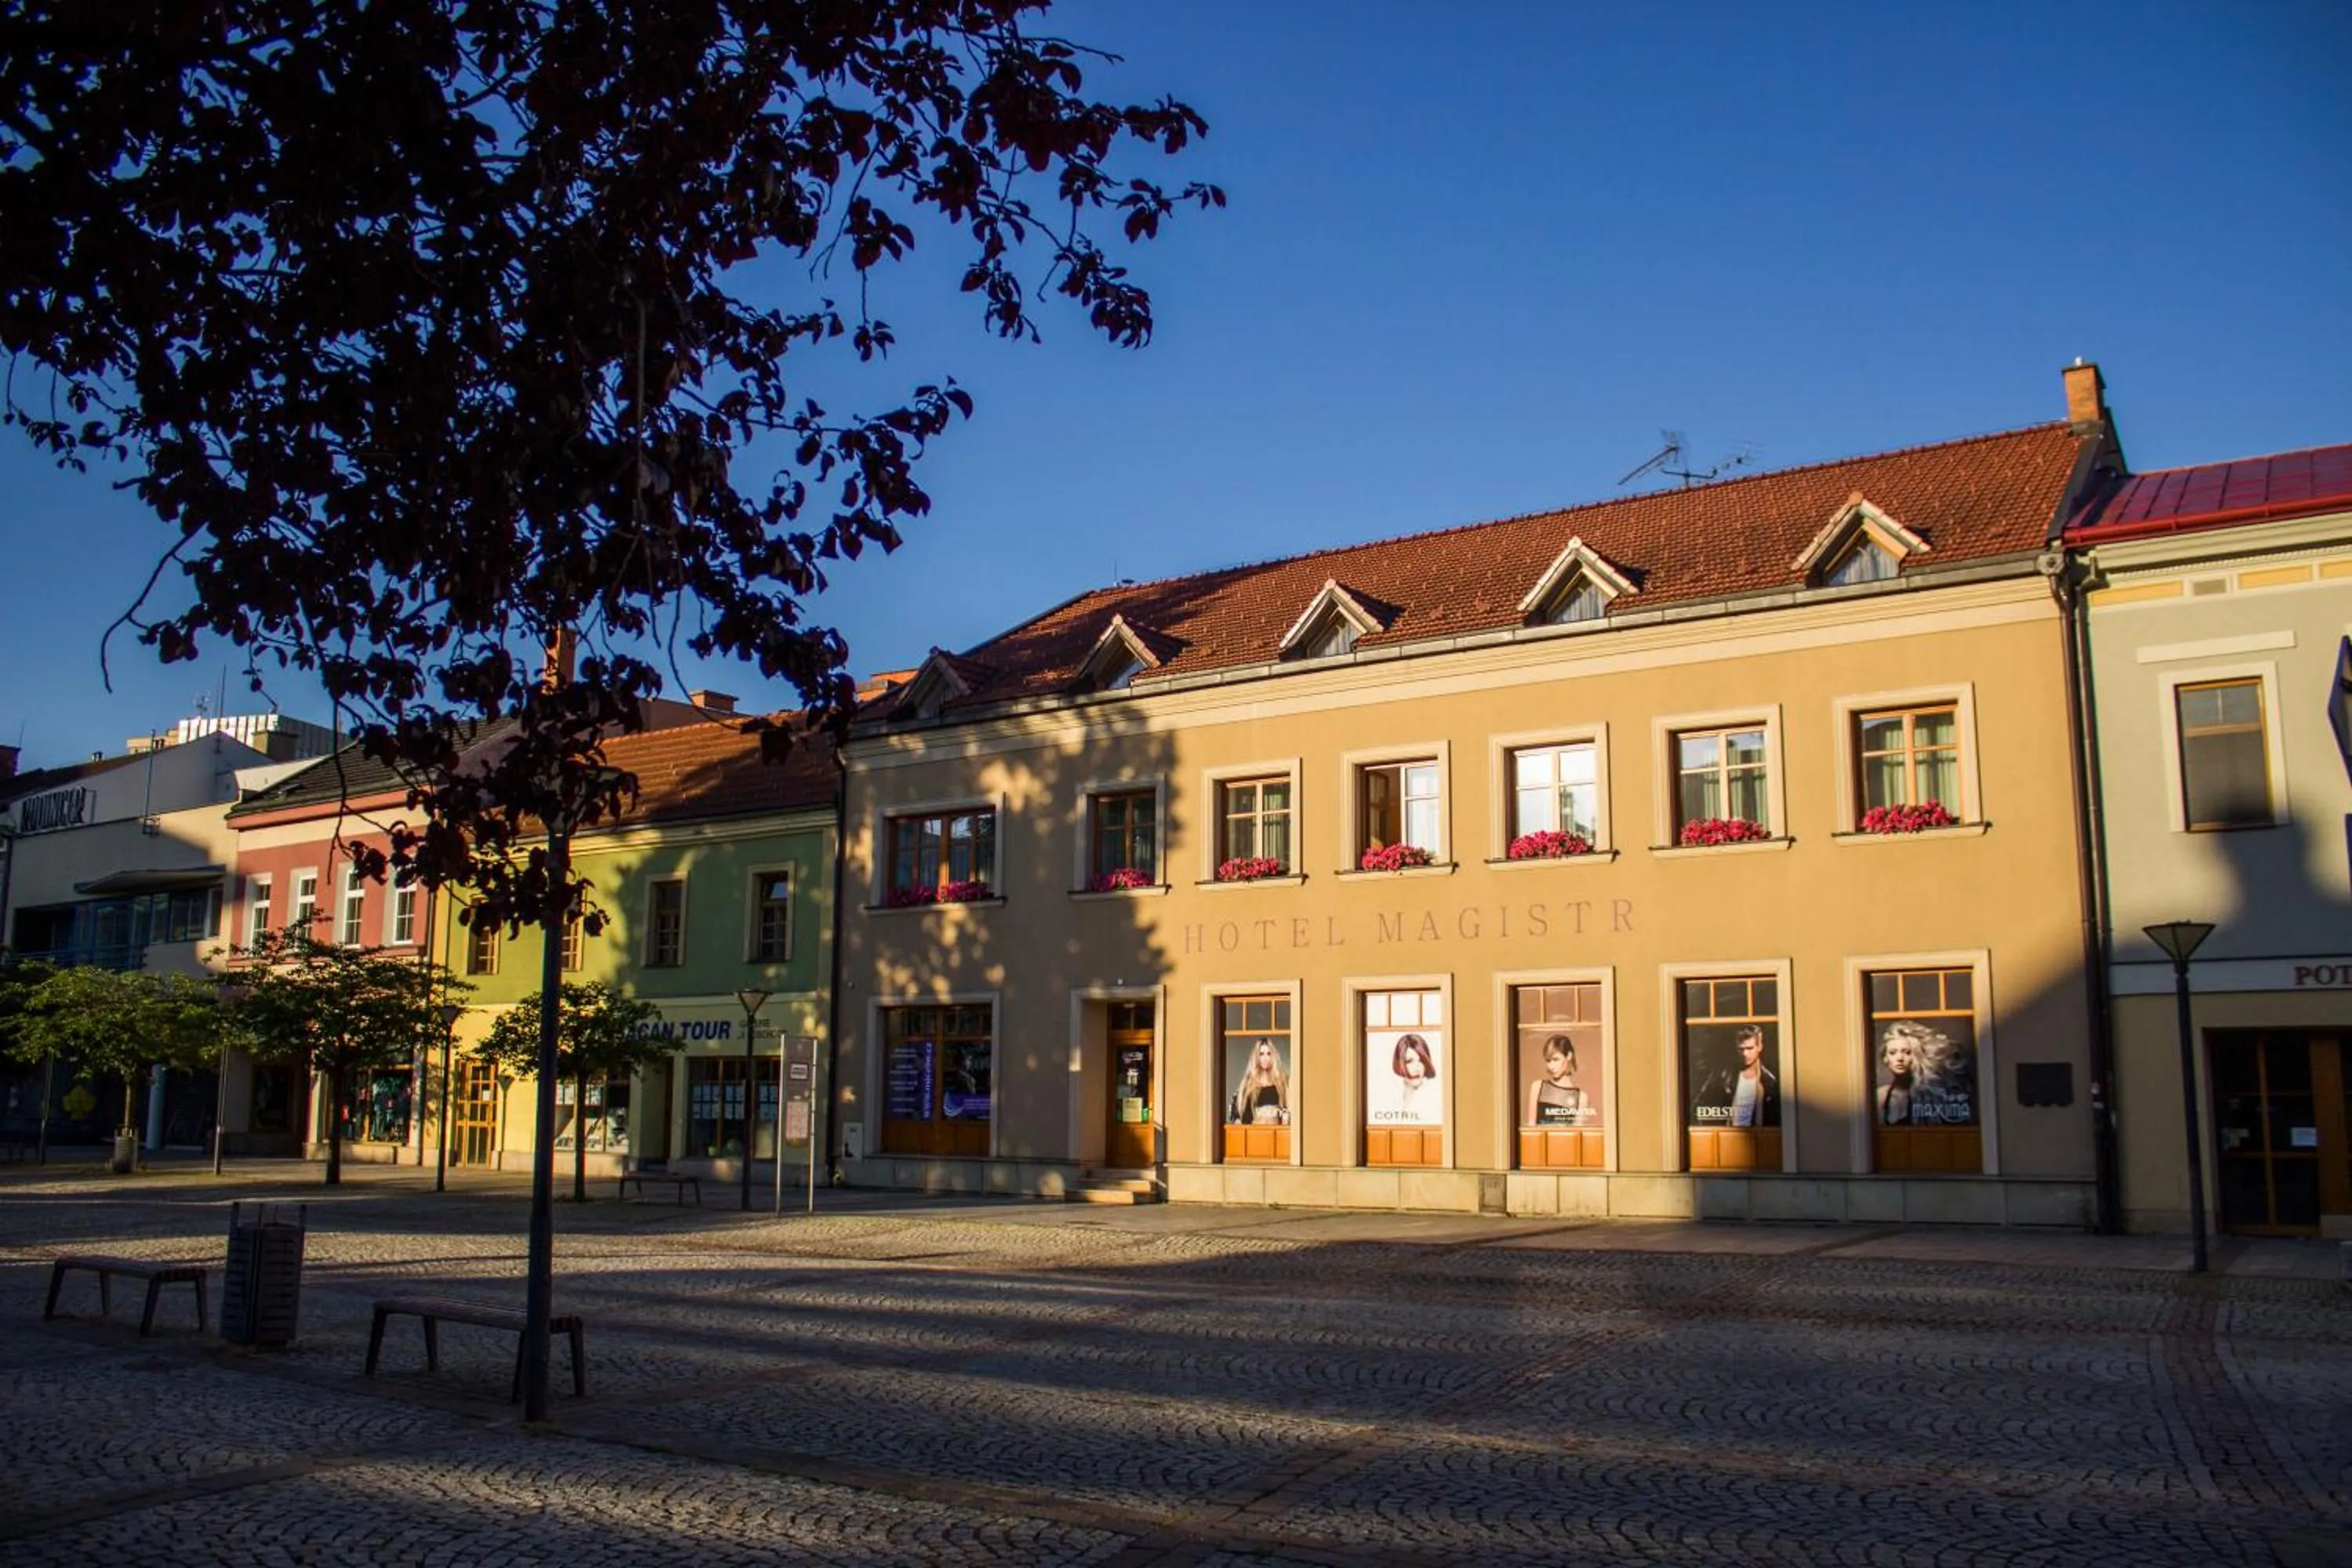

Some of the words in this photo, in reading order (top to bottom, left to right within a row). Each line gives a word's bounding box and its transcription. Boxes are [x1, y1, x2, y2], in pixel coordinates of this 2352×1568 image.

[1185, 915, 1345, 954] HOTEL
[1377, 898, 1633, 943] MAGISTR
[681, 1021, 731, 1040] TOUR
[1374, 1110, 1420, 1120] COTRIL
